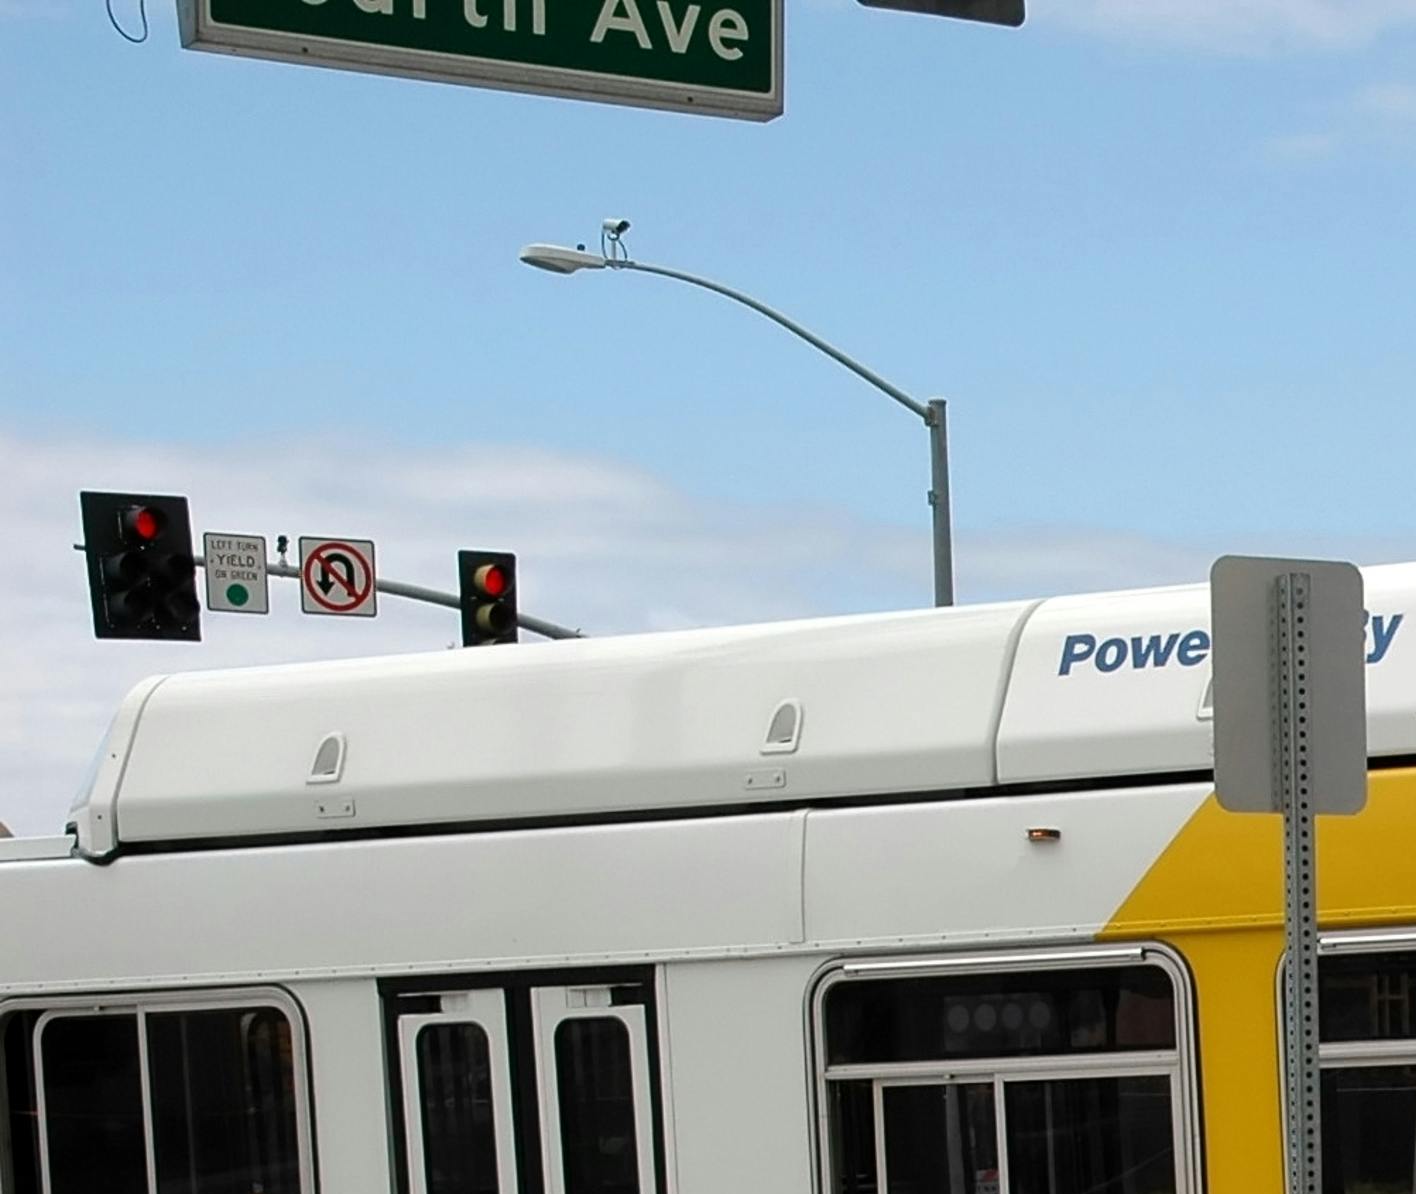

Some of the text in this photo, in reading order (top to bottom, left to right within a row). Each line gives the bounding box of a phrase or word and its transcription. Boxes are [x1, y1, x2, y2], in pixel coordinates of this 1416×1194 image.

[589, 0, 749, 61] Ave
[216, 553, 256, 568] YIELD
[1058, 628, 1211, 677] Powe
[1363, 608, 1404, 664] y
